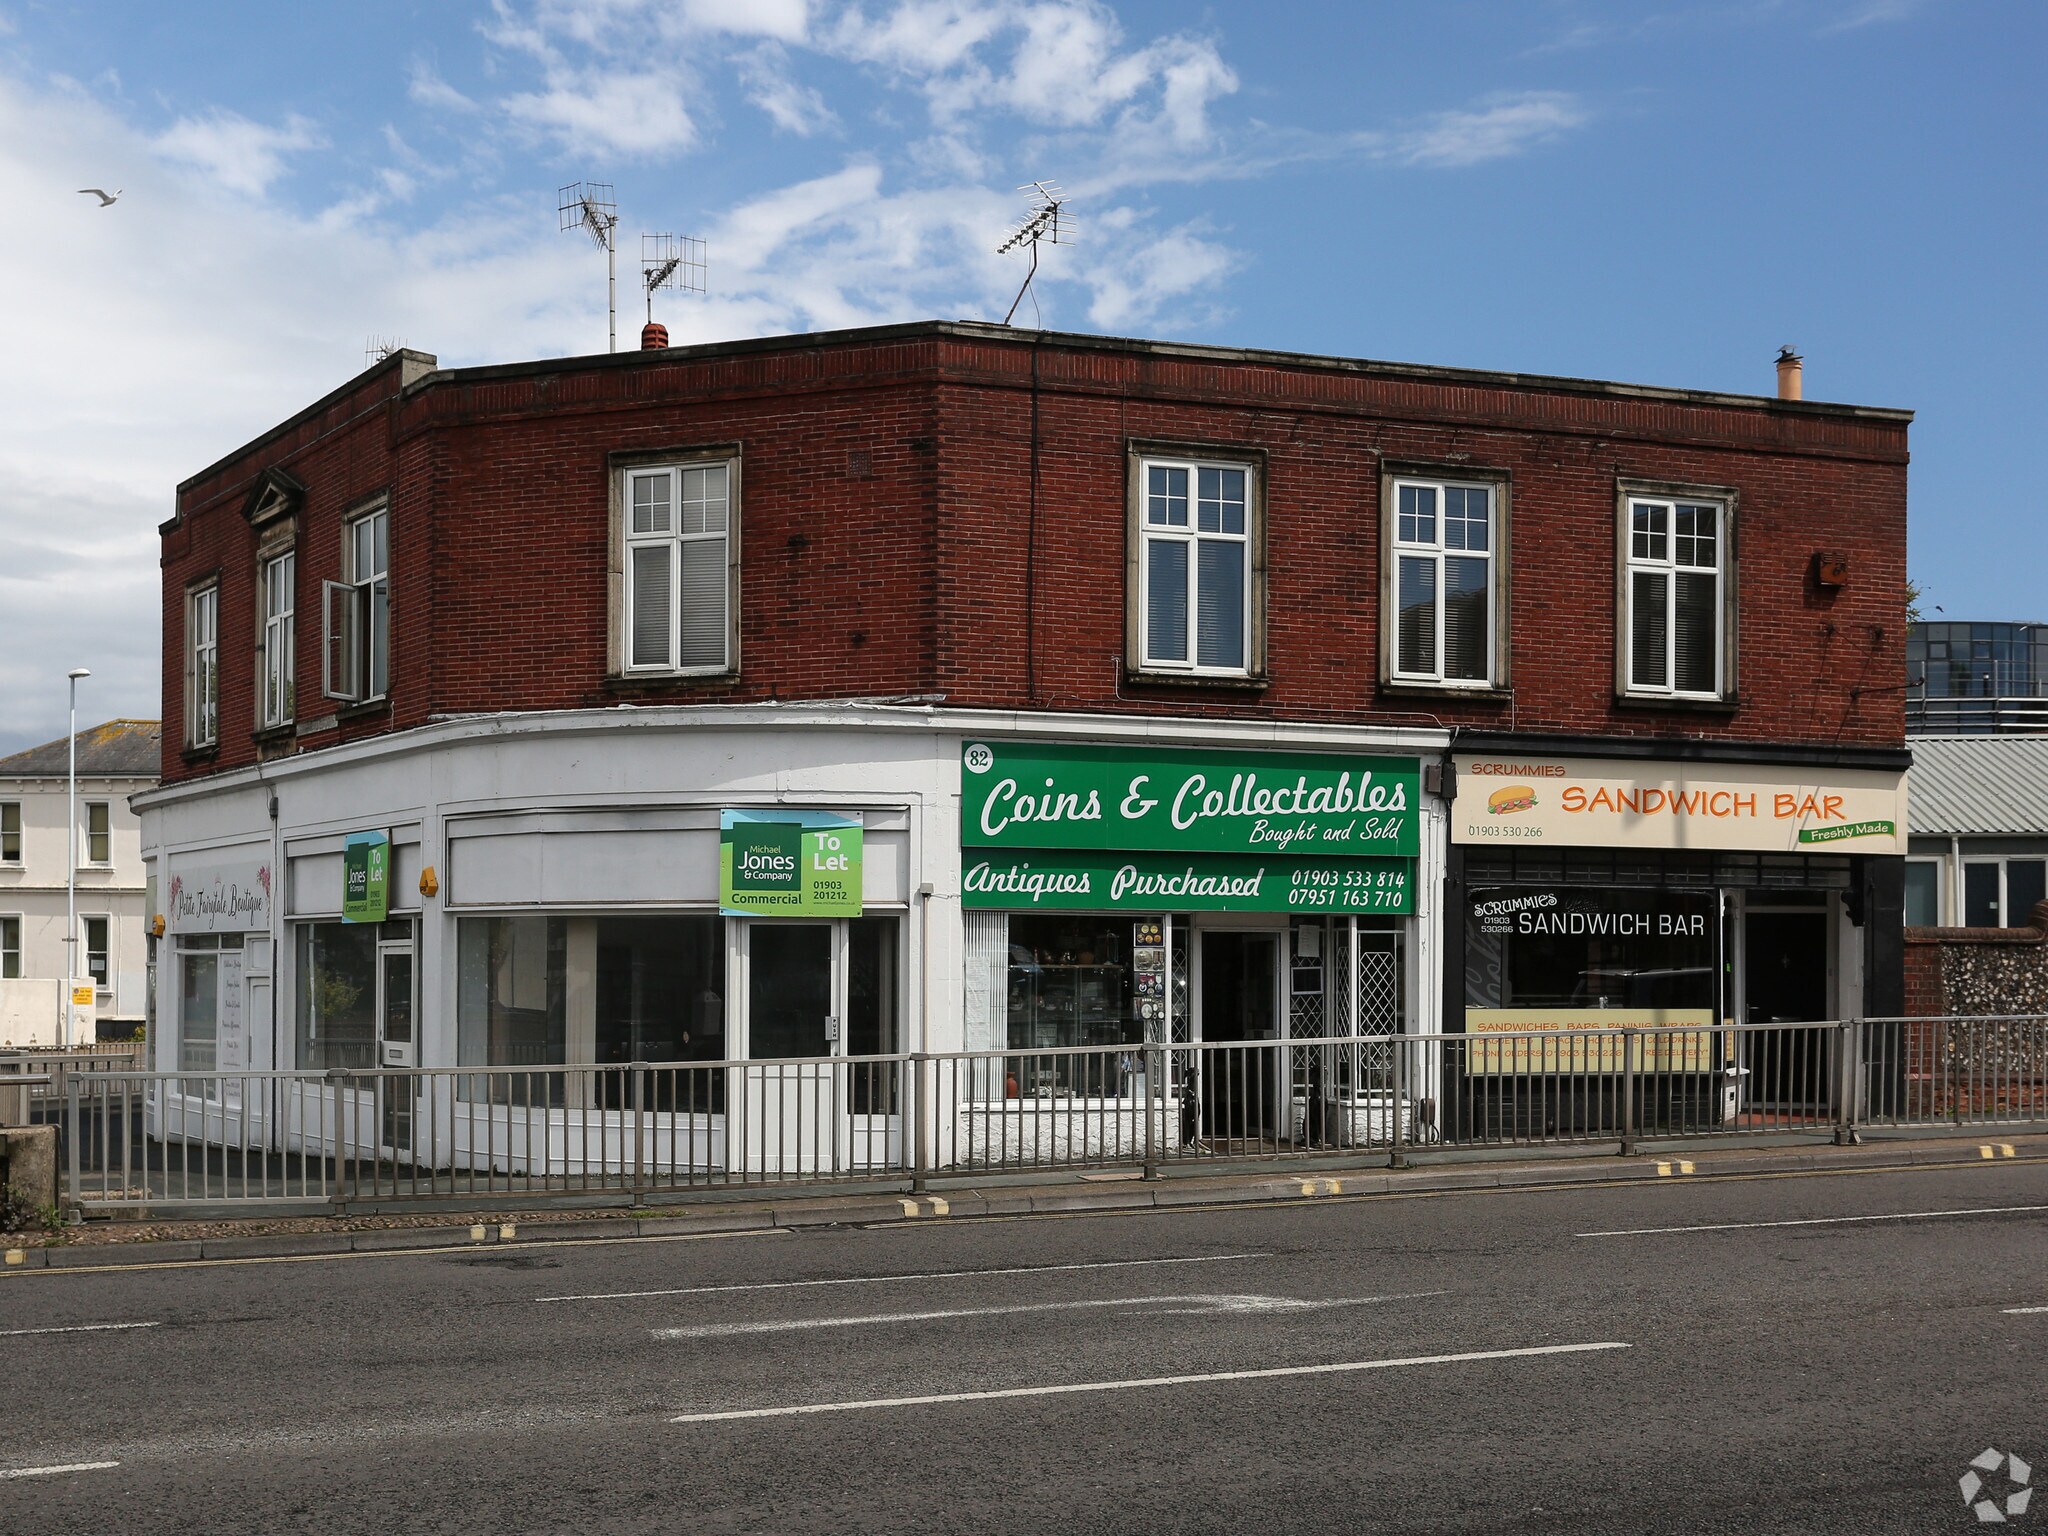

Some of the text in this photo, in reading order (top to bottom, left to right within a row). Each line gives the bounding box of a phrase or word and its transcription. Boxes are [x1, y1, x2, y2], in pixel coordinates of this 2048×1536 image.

[970, 750, 988, 767] 82
[1471, 763, 1566, 778] SCRUMMIES
[981, 771, 1407, 837] Coins & Collectables
[1561, 786, 1848, 821] SANDWICH BAR
[1249, 816, 1405, 851] Bought and Sold
[1468, 824, 1543, 839] 01903 530 266
[1811, 822, 1889, 842] Freshly Made
[750, 845, 781, 854] Michael
[814, 833, 841, 851] To
[371, 849, 381, 864] To
[738, 851, 795, 870] Jones
[814, 853, 849, 871] Let
[348, 868, 366, 884] Jones
[370, 867, 383, 881] Let
[963, 861, 1265, 903] Antiques Purchased
[1292, 869, 1406, 889] 01903 533 814
[813, 881, 842, 890] 01903
[732, 893, 802, 905] Commercial
[813, 892, 847, 900] 201212
[1288, 888, 1403, 909] 07951 163 710
[228, 884, 262, 927] Boutique
[1474, 893, 1558, 917] SCRUMMIES
[1481, 925, 1514, 933] 530266
[1484, 917, 1511, 925] 01903
[1519, 912, 1704, 936] SANDWICH BAR
[1478, 1022, 1559, 1032] SANDWICHES
[1544, 1036, 1583, 1045] SNACS
